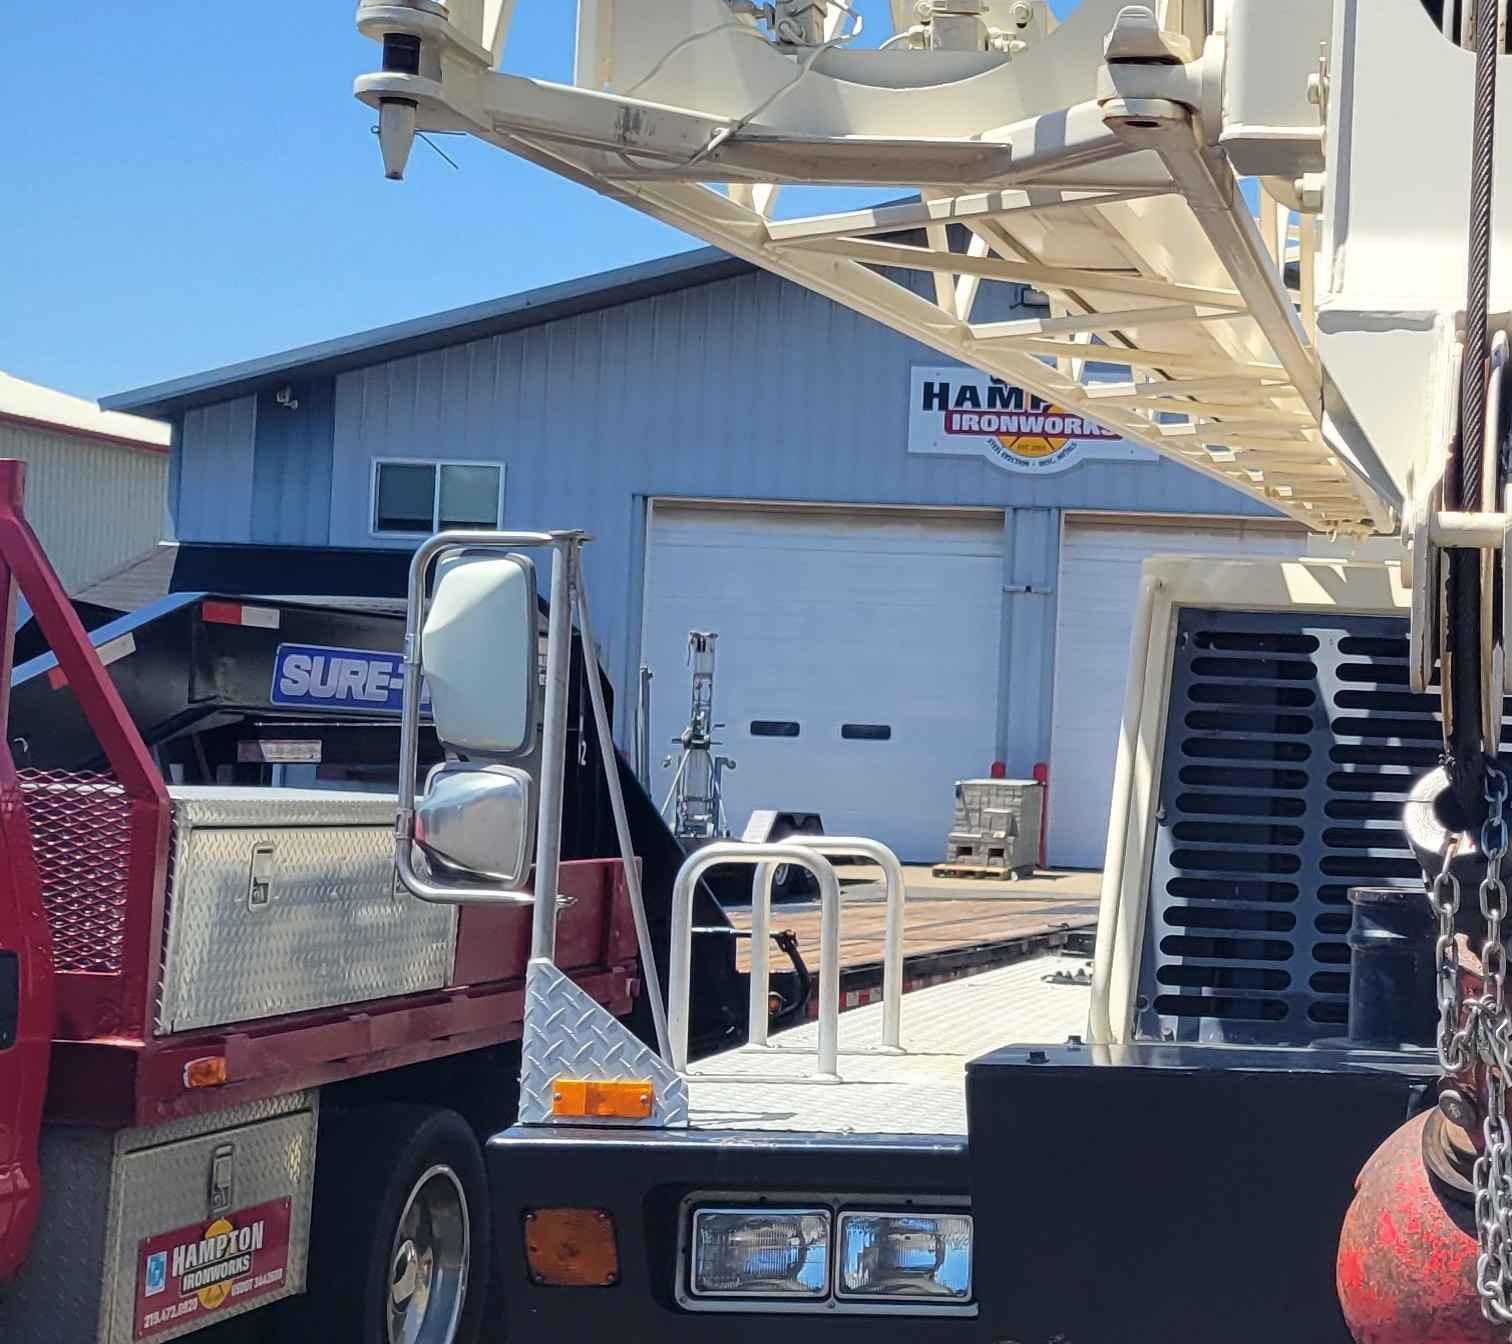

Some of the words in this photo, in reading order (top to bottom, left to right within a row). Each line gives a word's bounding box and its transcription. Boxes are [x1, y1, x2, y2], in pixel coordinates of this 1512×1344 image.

[951, 413, 1111, 436] IRONWORK
[279, 654, 416, 704] SURE-
[172, 1221, 265, 1278] HAMPTON
[182, 1254, 251, 1292] IRONWORKS
